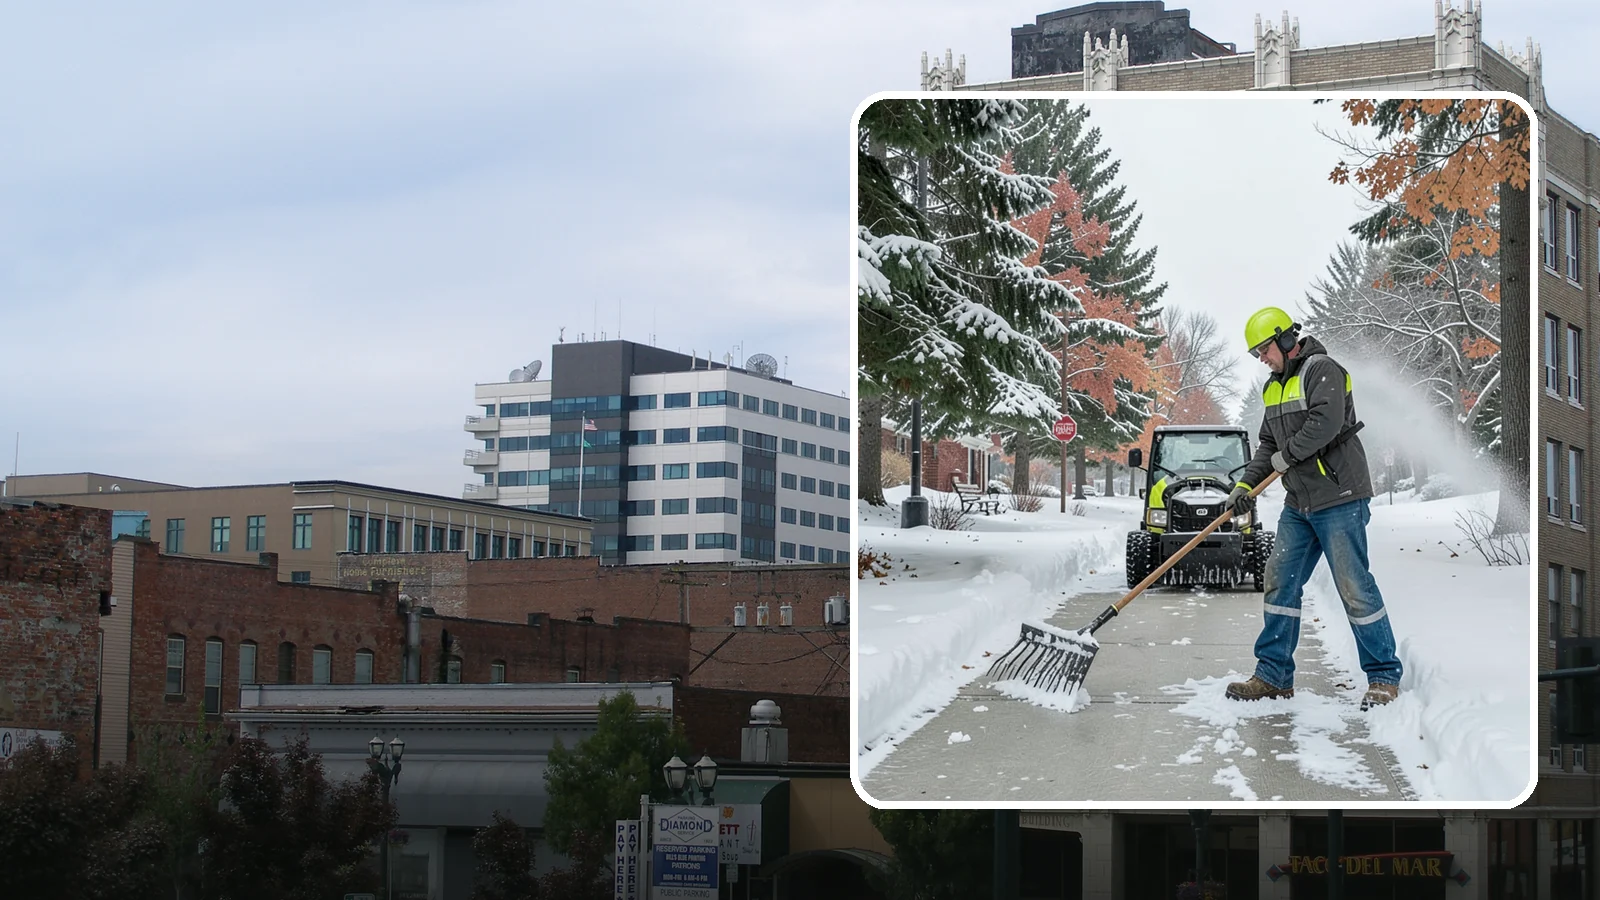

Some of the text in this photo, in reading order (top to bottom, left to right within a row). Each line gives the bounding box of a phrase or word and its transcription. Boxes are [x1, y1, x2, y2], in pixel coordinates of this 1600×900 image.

[343, 566, 427, 577] Home Furnishers
[660, 818, 713, 833] DIAMOND
[1022, 815, 1070, 828] BUILDING
[656, 845, 716, 854] RESERVED PARKING
[616, 825, 625, 894] PAY HERE
[627, 824, 637, 893] PAY HERE
[721, 852, 739, 862] Soup
[671, 862, 701, 870] PATRONS
[1289, 855, 1442, 877] TAC DEL MAR
[660, 889, 710, 898] PUBLIC PARKING
